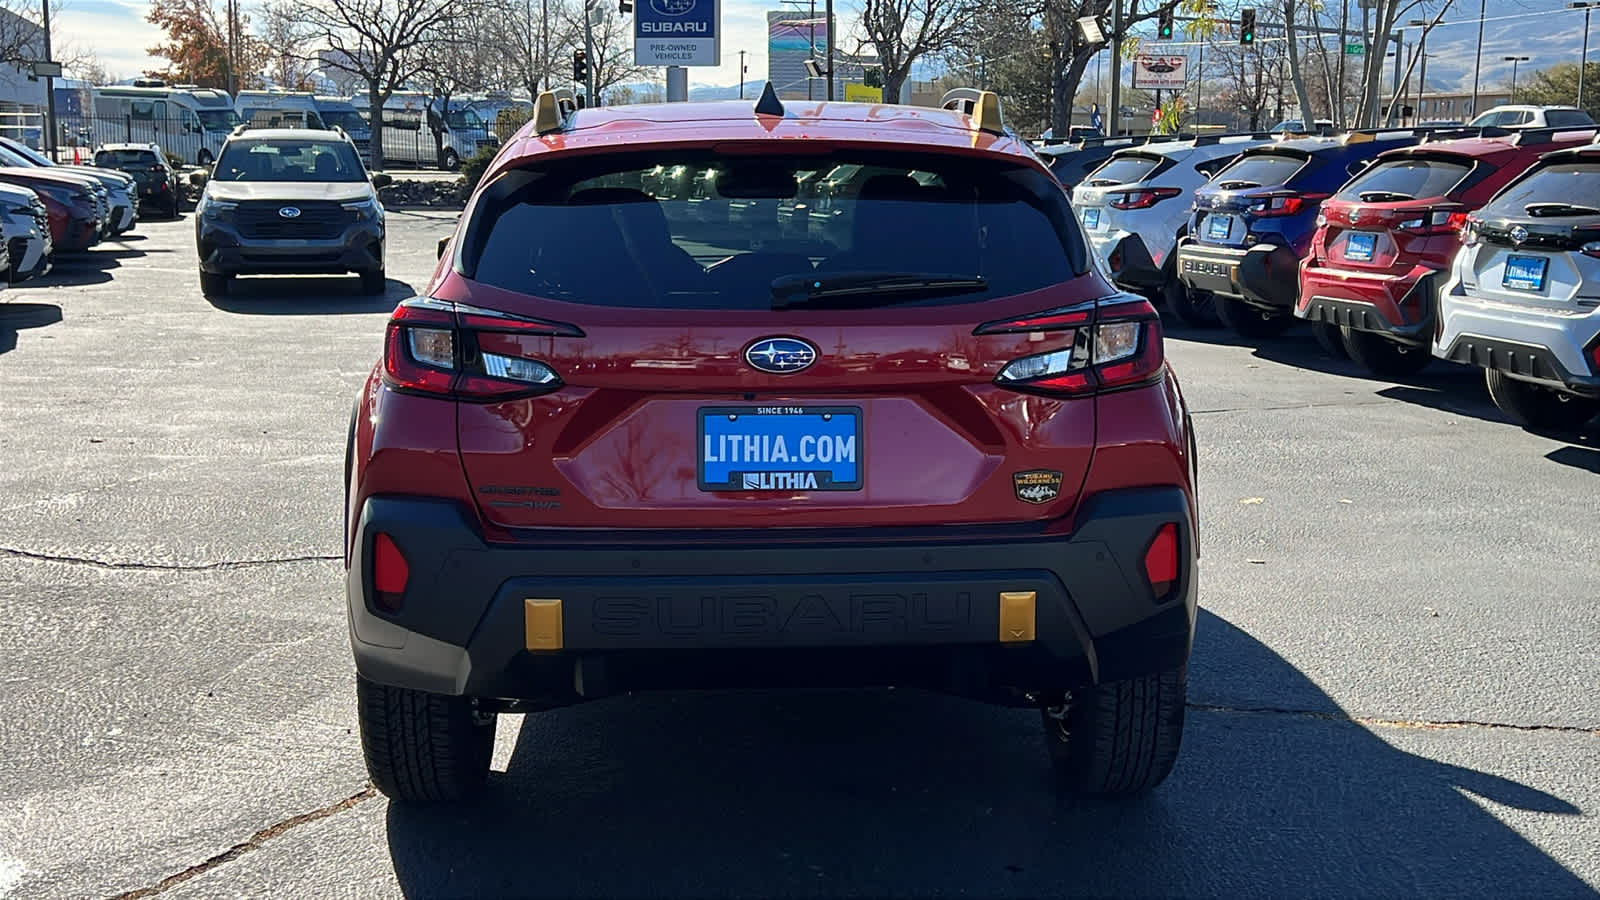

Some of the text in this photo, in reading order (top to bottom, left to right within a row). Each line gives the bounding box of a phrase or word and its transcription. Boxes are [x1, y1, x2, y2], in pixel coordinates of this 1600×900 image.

[641, 22, 707, 32] SUBARU
[654, 52, 693, 60] VEHICLES
[1185, 262, 1228, 277] SUBARU
[757, 407, 804, 415] SINCE 1946
[704, 434, 856, 463] LITHIA.COM
[760, 473, 818, 489] LITHIA
[591, 592, 974, 636] SUBARU
